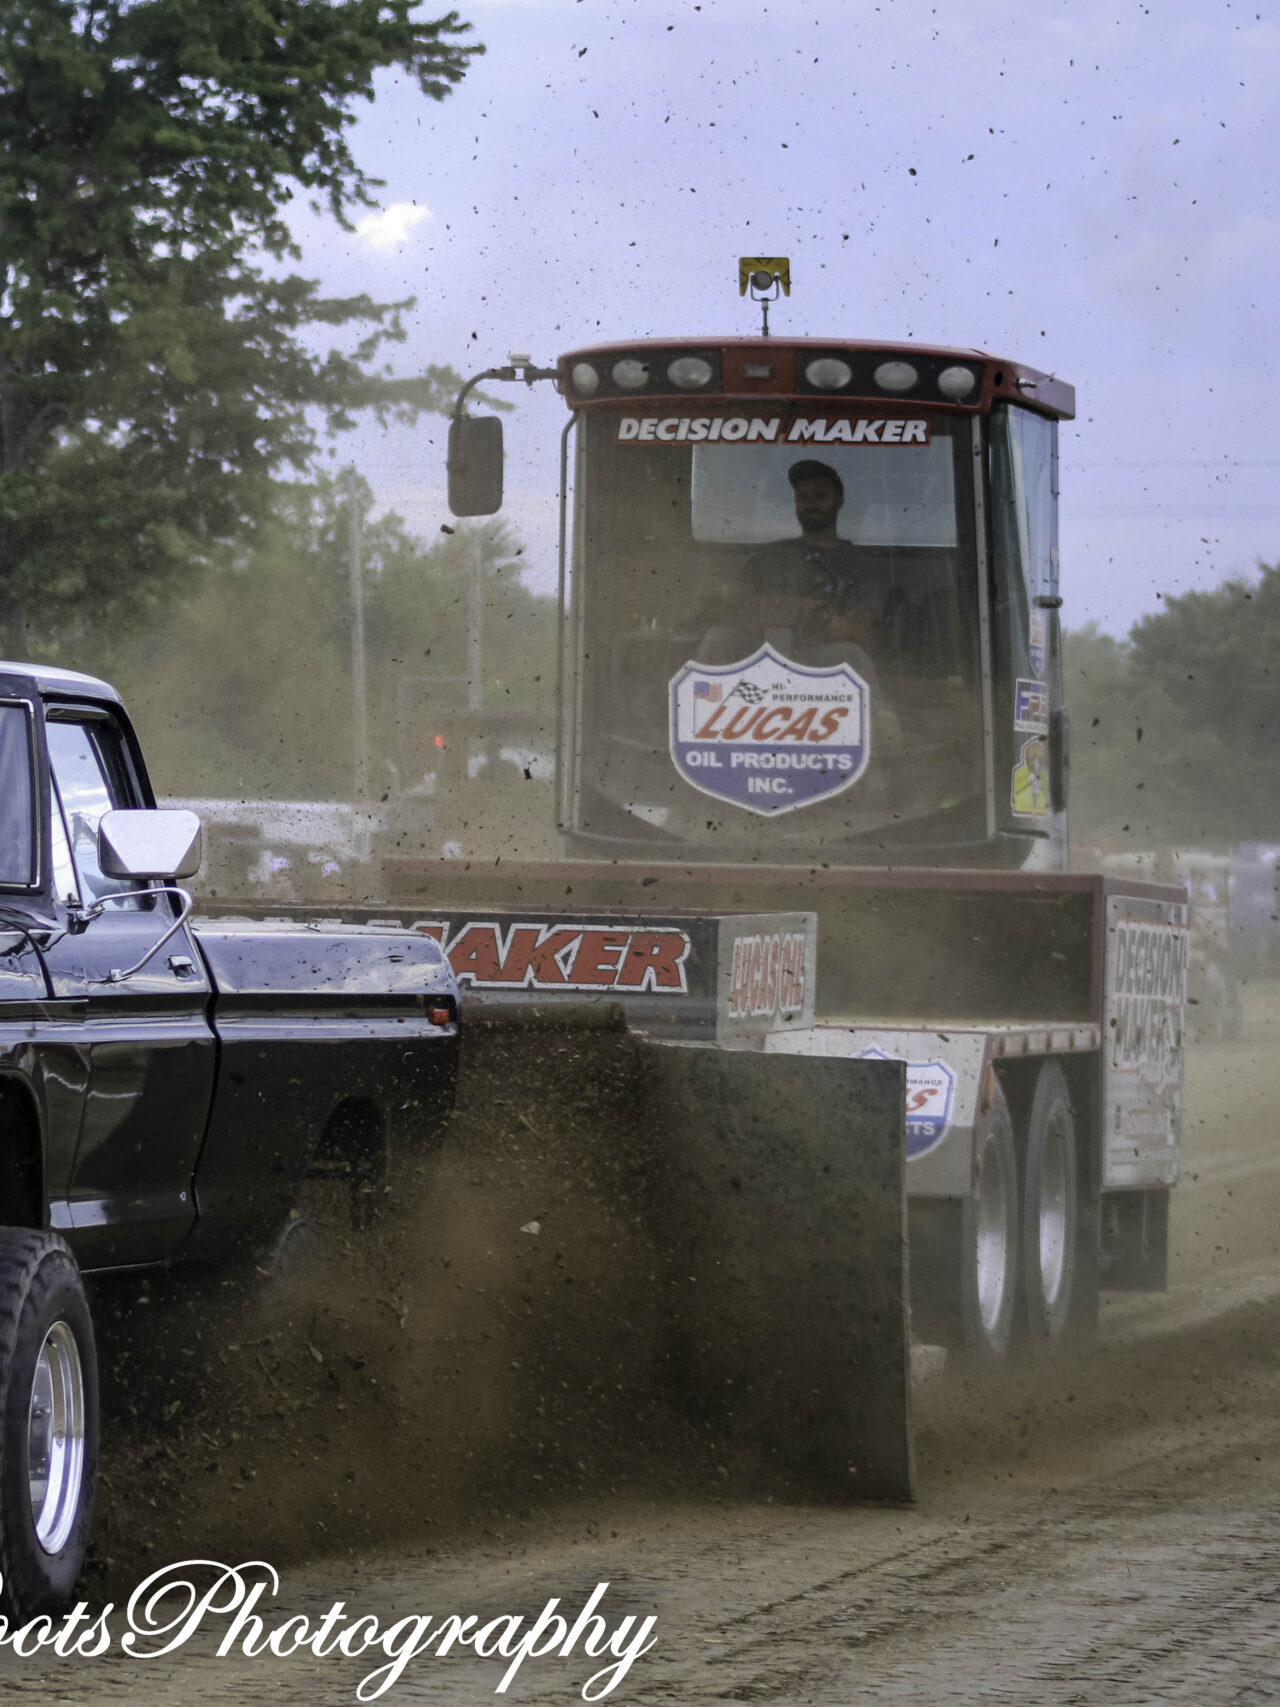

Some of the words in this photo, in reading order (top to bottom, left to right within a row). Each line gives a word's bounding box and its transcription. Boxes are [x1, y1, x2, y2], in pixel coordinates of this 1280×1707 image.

[617, 417, 781, 441] DECISION
[786, 417, 929, 443] MAKER
[772, 693, 853, 703] PERFORMANCE
[693, 705, 850, 742] LUCAS
[685, 751, 723, 768] OIL
[730, 751, 853, 770] PRODUCTS
[747, 776, 794, 794] INC.
[728, 934, 779, 1017] LUCAS
[780, 933, 804, 1014] OIL
[1113, 922, 1188, 1002] DECISION
